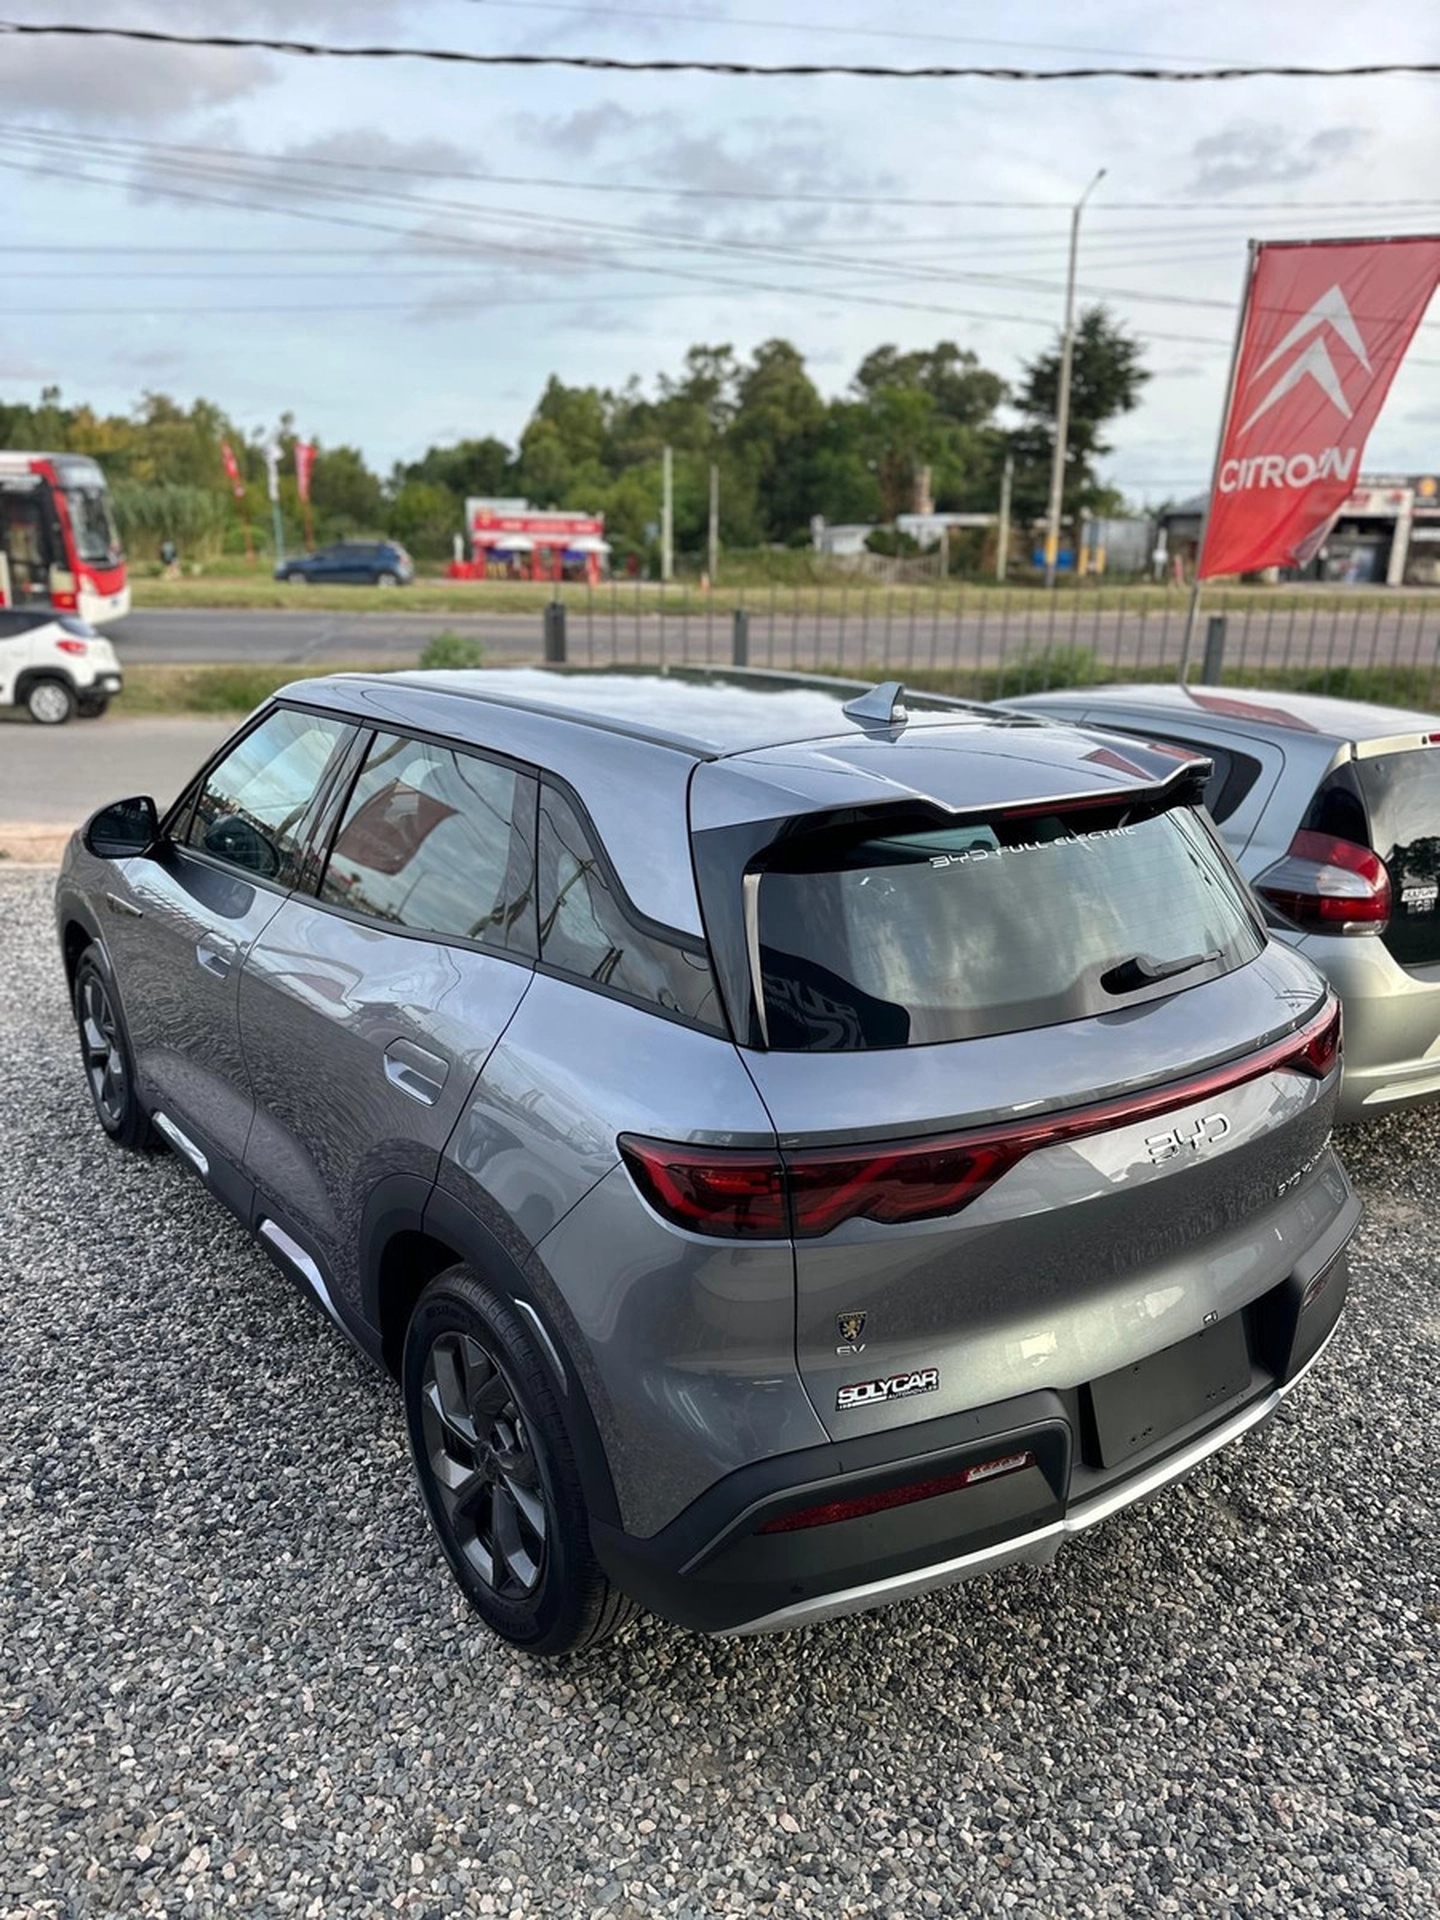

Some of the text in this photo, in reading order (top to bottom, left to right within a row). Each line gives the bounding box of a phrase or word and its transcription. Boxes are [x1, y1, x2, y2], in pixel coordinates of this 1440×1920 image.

[929, 826, 1137, 868] BYD FULL ELECTRIC
[1145, 1112, 1231, 1165] BYD
[836, 1344, 866, 1356] EV
[837, 1369, 938, 1405] SOLYCAR
